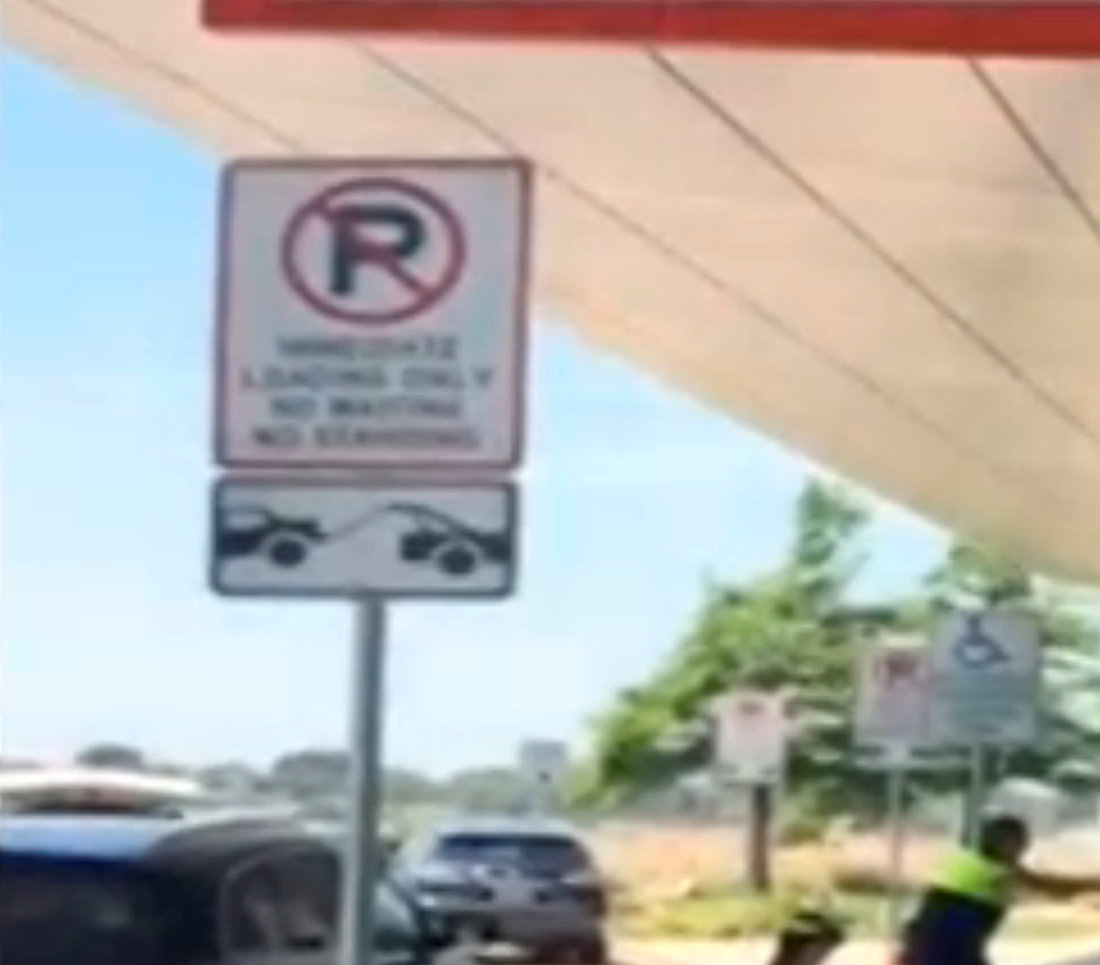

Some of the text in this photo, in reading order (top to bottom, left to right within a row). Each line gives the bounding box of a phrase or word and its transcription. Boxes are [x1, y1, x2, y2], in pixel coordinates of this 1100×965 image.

[241, 365, 494, 388] LOADING ONLY
[270, 397, 462, 419] NO WAITING
[252, 426, 480, 449] NO STANDING
